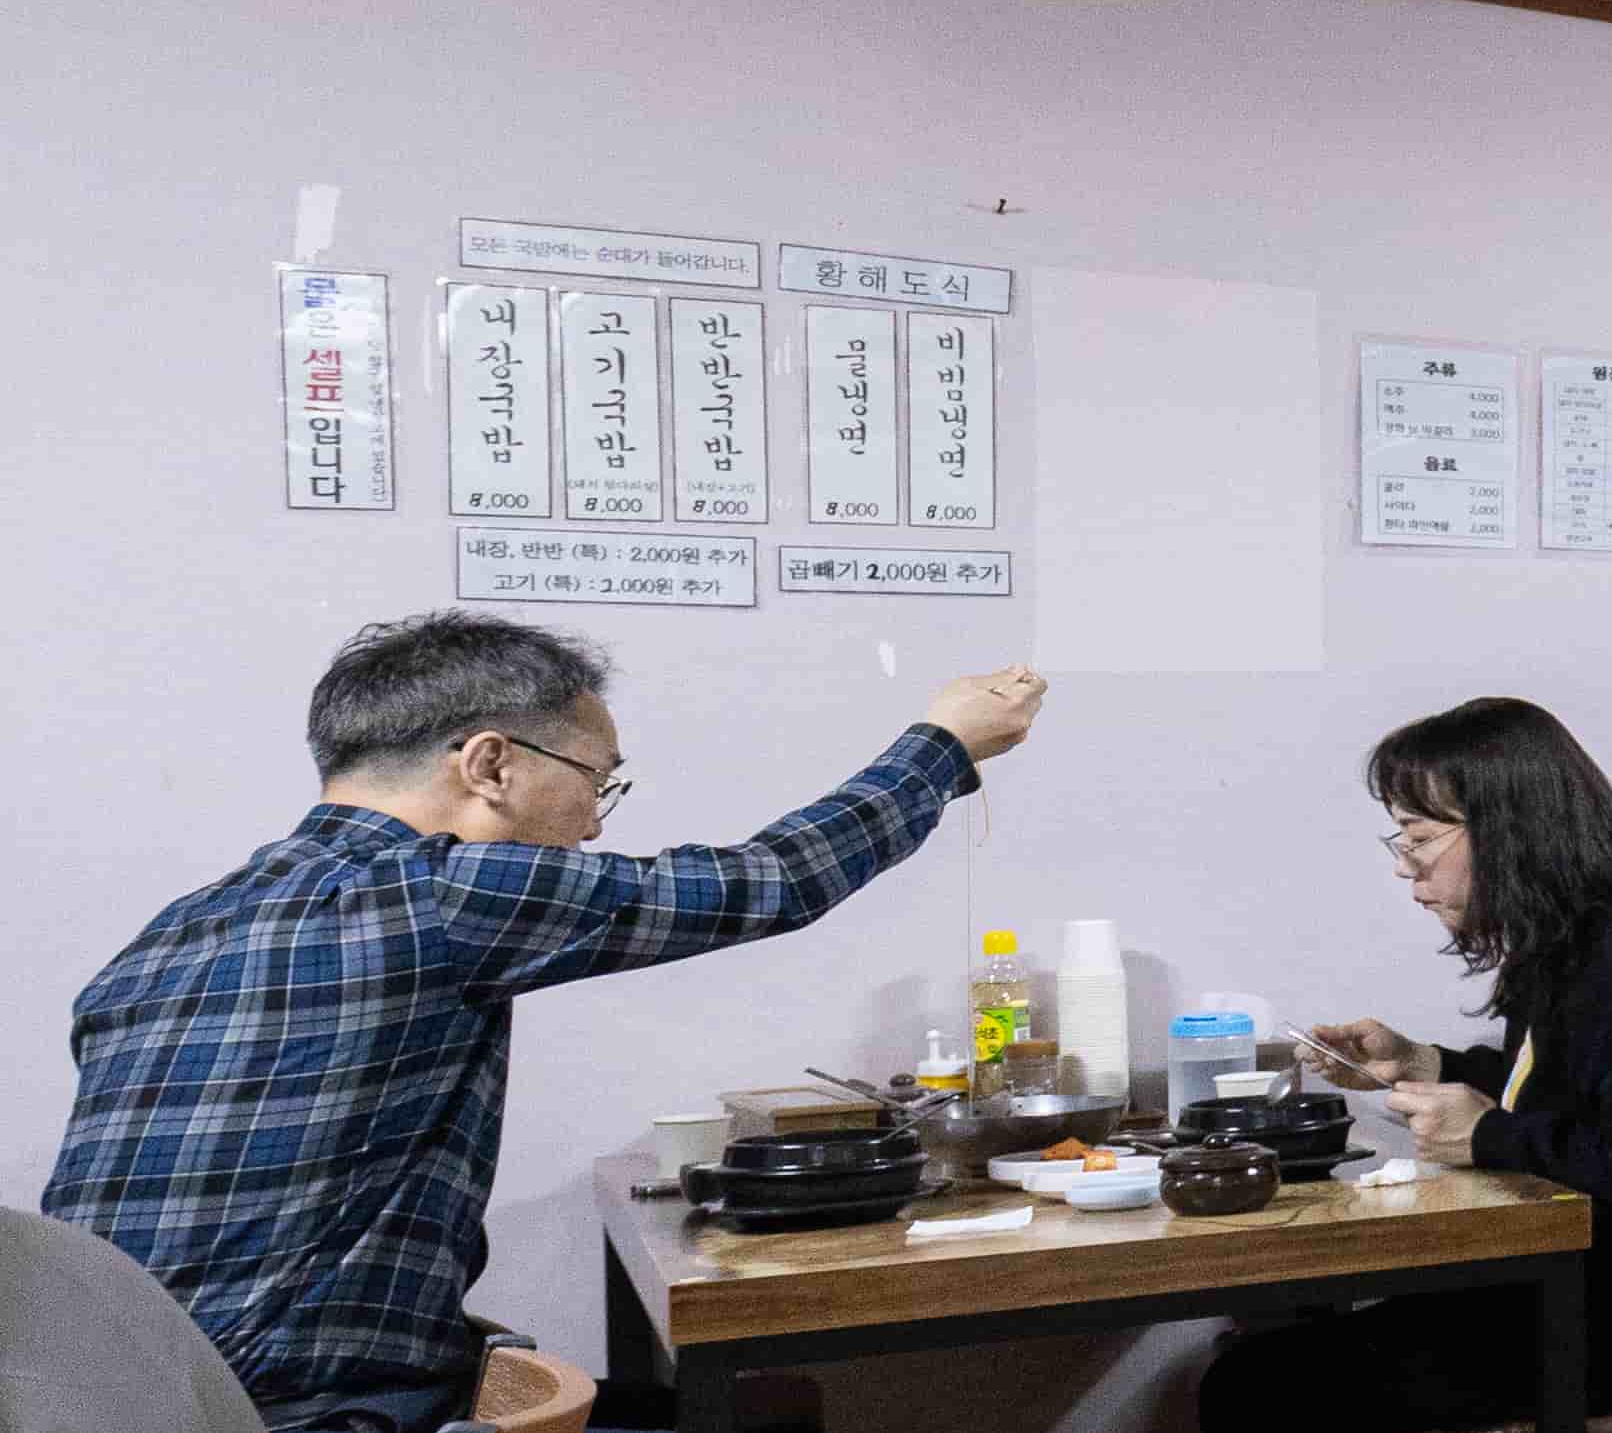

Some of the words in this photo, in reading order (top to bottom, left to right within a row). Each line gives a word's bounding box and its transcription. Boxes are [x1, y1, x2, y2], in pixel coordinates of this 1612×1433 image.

[469, 235, 507, 256] 모든
[596, 246, 650, 266] 순대가
[479, 297, 523, 464] 내장국밥
[1424, 361, 1457, 377] 주류
[588, 311, 636, 470] 고기국밥
[699, 312, 743, 473] 반반국밥
[835, 338, 870, 456] 물냉면
[938, 326, 969, 479] 비빔냉면
[1424, 456, 1459, 472] 음료
[468, 491, 529, 511] 8,000
[584, 497, 642, 513] 8,000
[692, 499, 748, 516] 8,000
[825, 502, 879, 518] 8,000
[926, 504, 977, 521] 8,000
[522, 542, 564, 560] 반반
[631, 546, 700, 565] 2,000원
[707, 550, 748, 567] 추가
[788, 559, 859, 581] 곱빼기
[865, 562, 950, 583] 2,000원
[955, 562, 1003, 585] 추가
[494, 573, 536, 592] 고기
[682, 579, 721, 597] 추가
